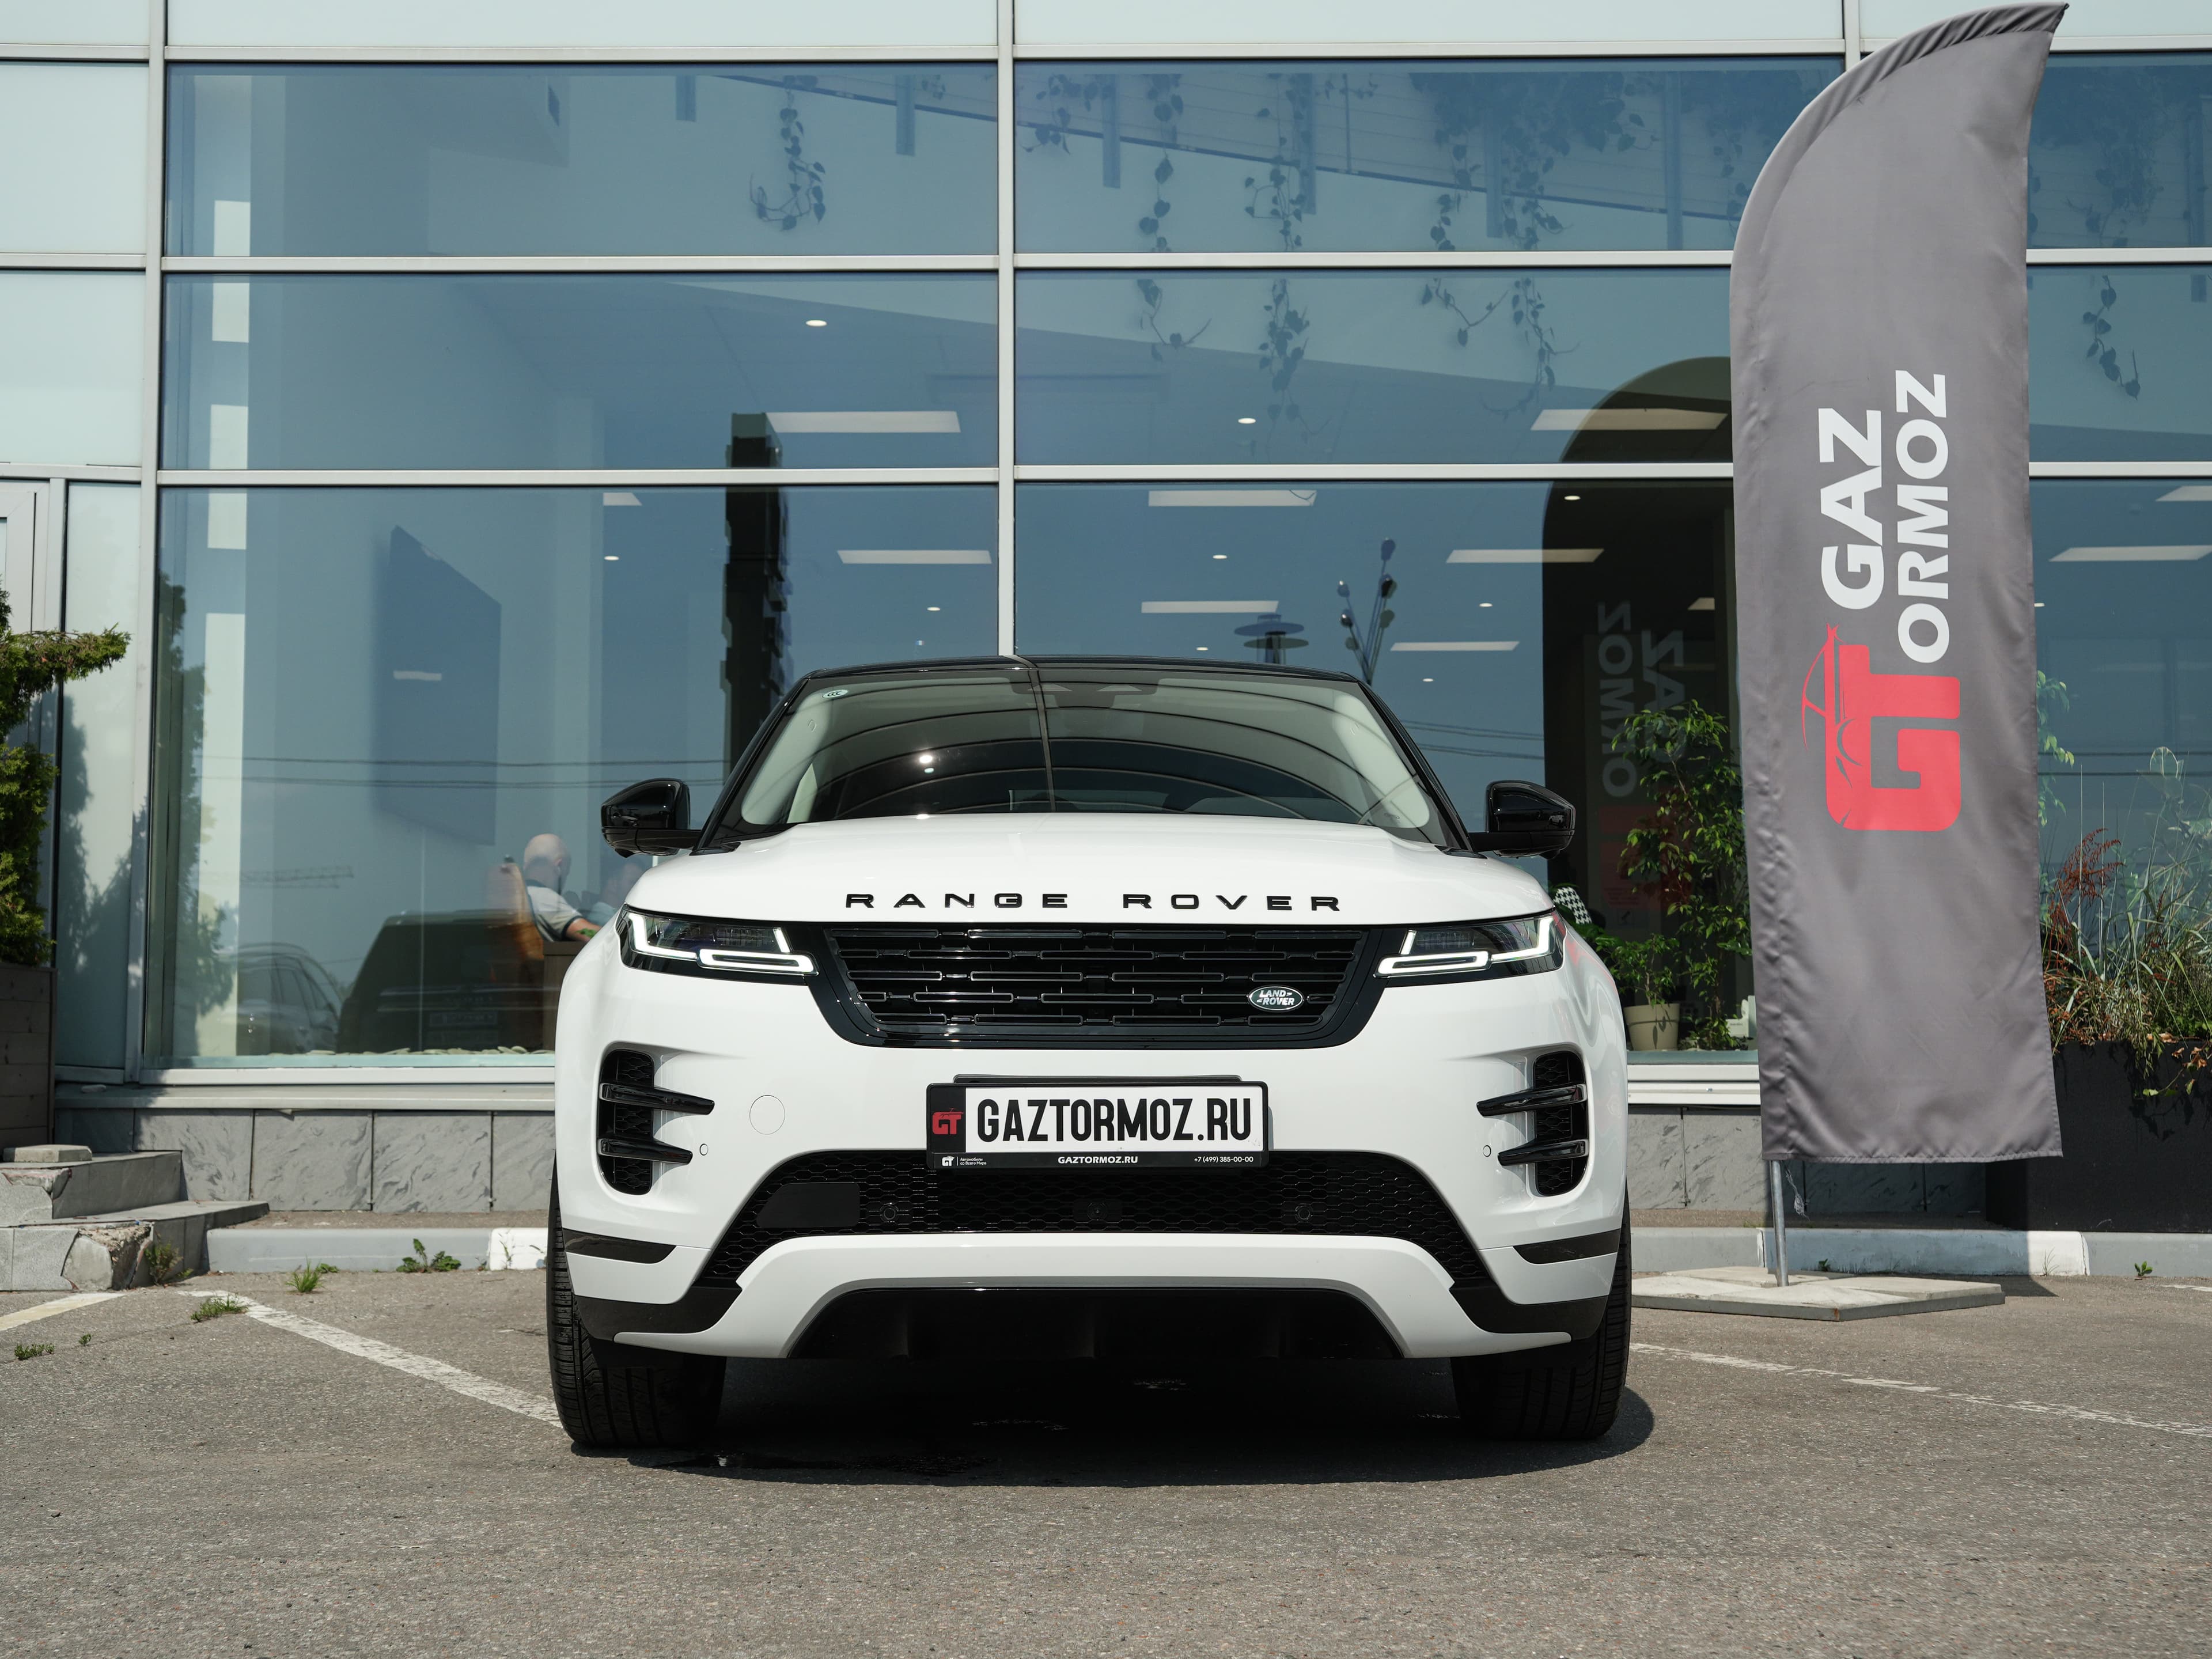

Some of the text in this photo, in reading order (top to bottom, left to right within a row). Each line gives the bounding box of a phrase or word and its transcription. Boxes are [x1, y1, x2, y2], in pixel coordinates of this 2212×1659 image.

[1818, 408, 1884, 609] GAZ
[1895, 370, 1949, 663] ORMOZ
[1801, 623, 1961, 831] GT
[845, 893, 1340, 911] RANGE ROVER
[1262, 997, 1294, 1005] ROVER
[932, 1111, 964, 1135] GT
[978, 1098, 1251, 1142] GAZTORMOZ.RU
[942, 1156, 955, 1166] GT
